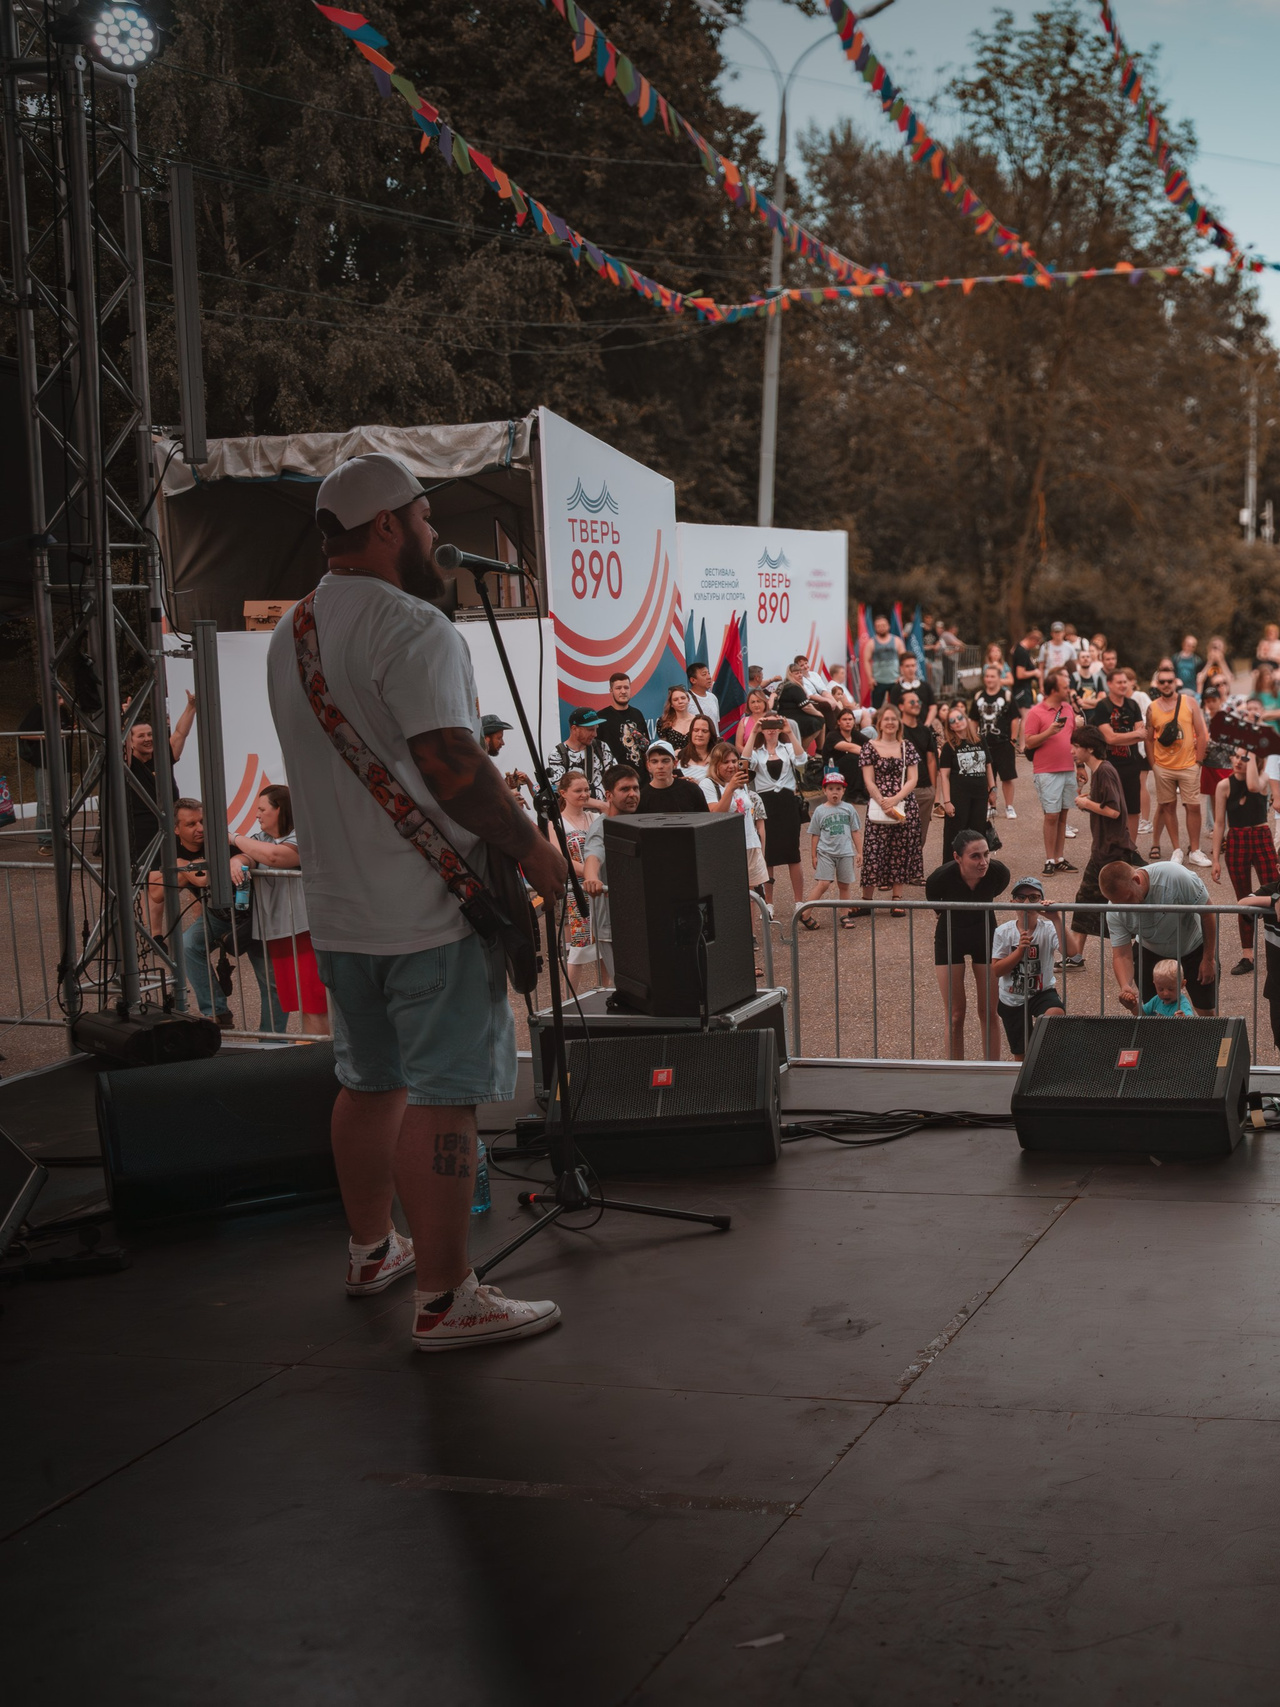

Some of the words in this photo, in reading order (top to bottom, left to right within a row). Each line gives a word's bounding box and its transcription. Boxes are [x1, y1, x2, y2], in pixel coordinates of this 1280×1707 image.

[567, 518, 620, 544] ТВЕРЬ
[571, 549, 622, 599] 890
[704, 568, 735, 576] ФЕСТИВАЛЬ
[701, 579, 739, 588] СОВРЕМЕННОЙ
[757, 573, 791, 588] ТВЕРЬ
[694, 592, 720, 601] КУЛЬТУРЫ
[726, 592, 745, 600] СПОРТА
[758, 592, 790, 624] 890
